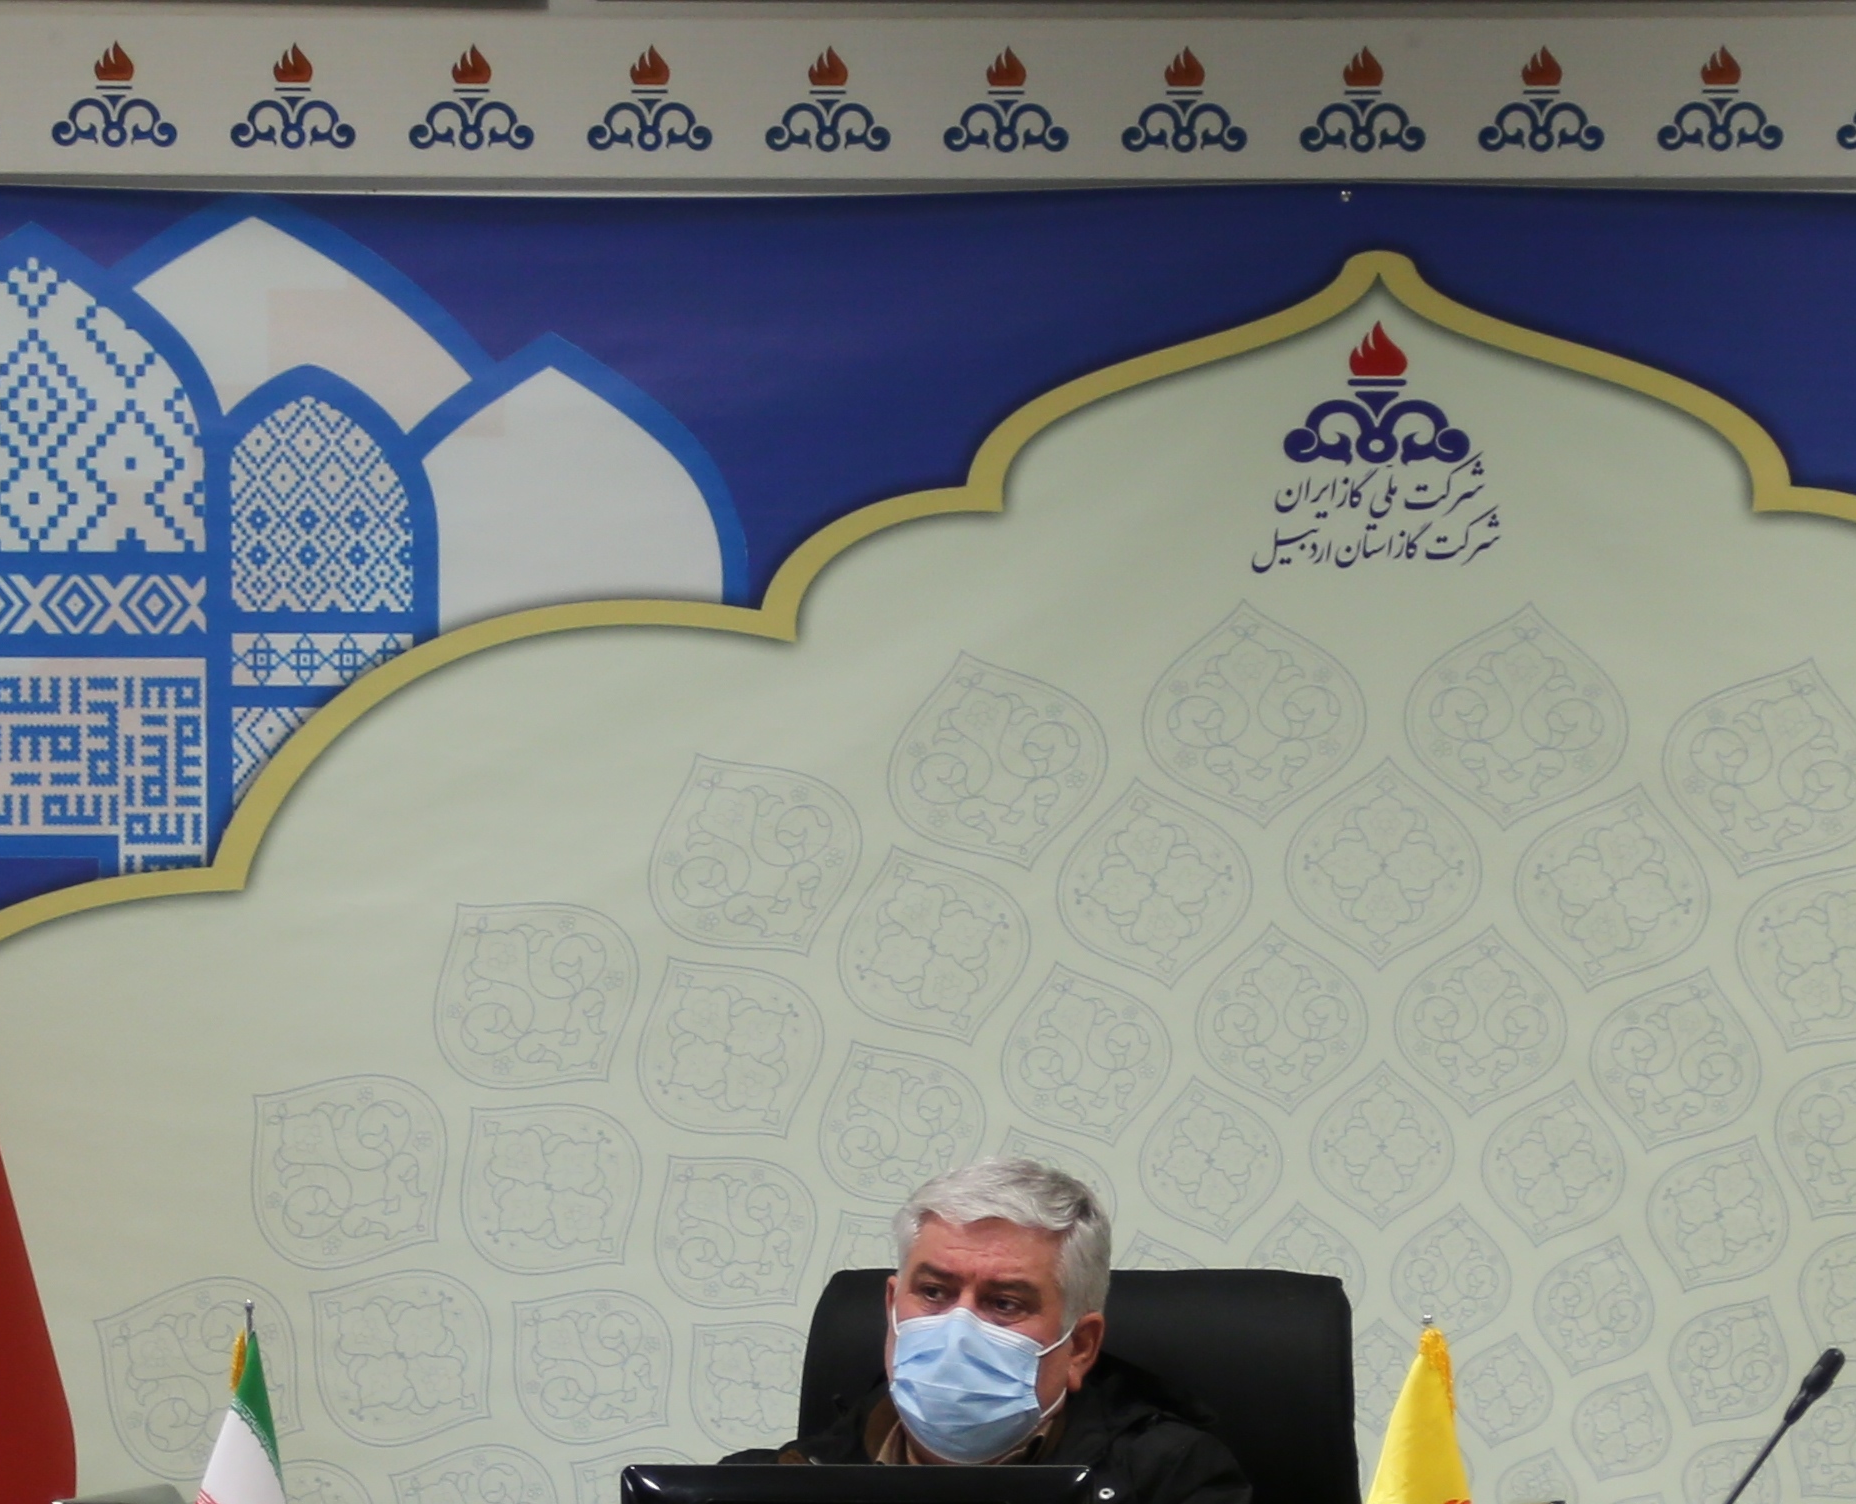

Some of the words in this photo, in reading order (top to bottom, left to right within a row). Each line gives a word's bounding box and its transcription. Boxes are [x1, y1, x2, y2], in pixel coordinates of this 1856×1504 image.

[1275, 476, 1338, 519] ایران
[1336, 467, 1379, 508] گاز
[1370, 464, 1398, 519] ملی
[1404, 451, 1486, 516] شرکت
[1251, 527, 1333, 574] اردبیل
[1335, 523, 1393, 569] استان
[1393, 521, 1434, 560] گاز
[1424, 505, 1501, 566] شرکت
